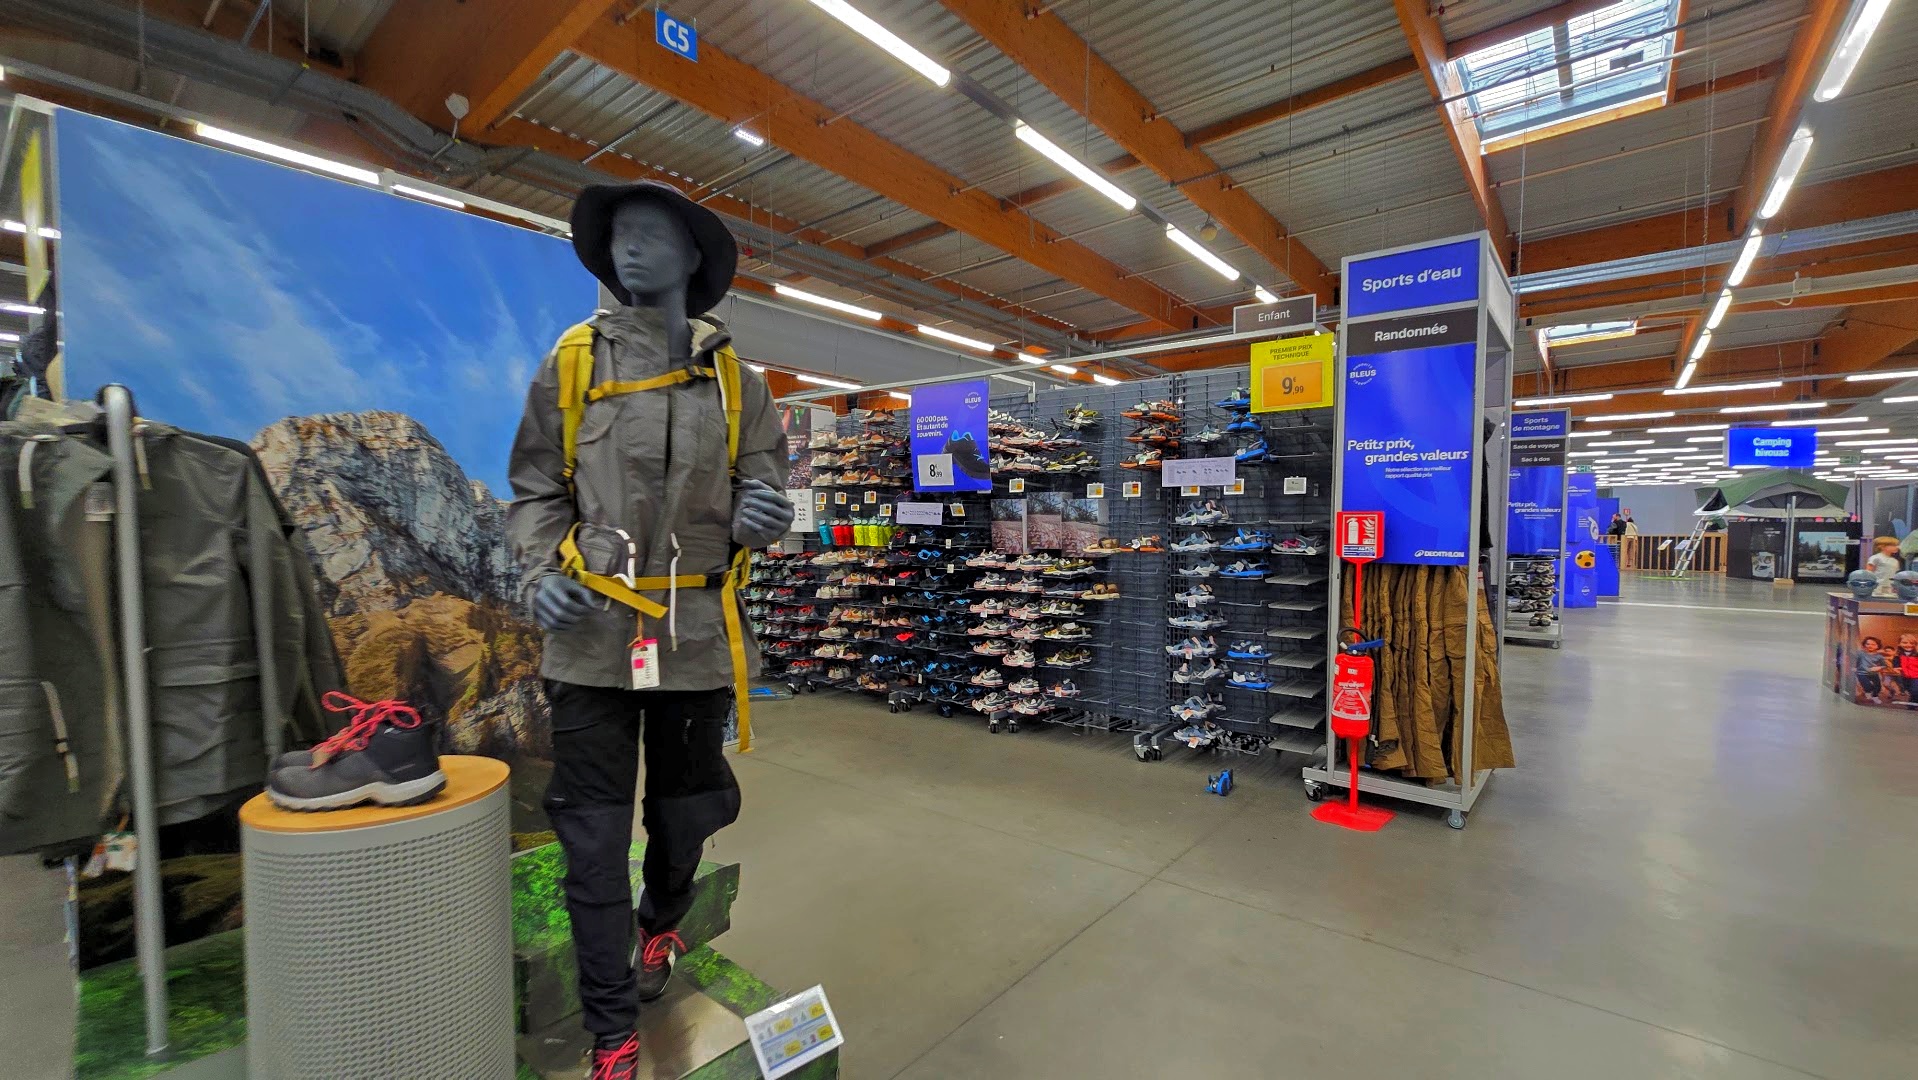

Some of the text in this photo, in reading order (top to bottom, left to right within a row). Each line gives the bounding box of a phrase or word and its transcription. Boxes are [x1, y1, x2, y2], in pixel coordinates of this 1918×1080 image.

[663, 18, 690, 53] C5
[1362, 273, 1414, 293] Sports
[1258, 309, 1290, 322] Enfant
[1374, 323, 1448, 342] Randonnée
[1270, 346, 1297, 355] PREMIER
[1273, 350, 1309, 360] TECHNIQUE
[1350, 369, 1377, 379] BLEUS
[1524, 417, 1549, 425] Sports
[1523, 424, 1560, 432] montagne
[1347, 437, 1415, 451] Petits prix,
[1752, 437, 1792, 448] Camping
[1365, 449, 1469, 465] grandes valeurs
[1754, 448, 1789, 457] bivouac
